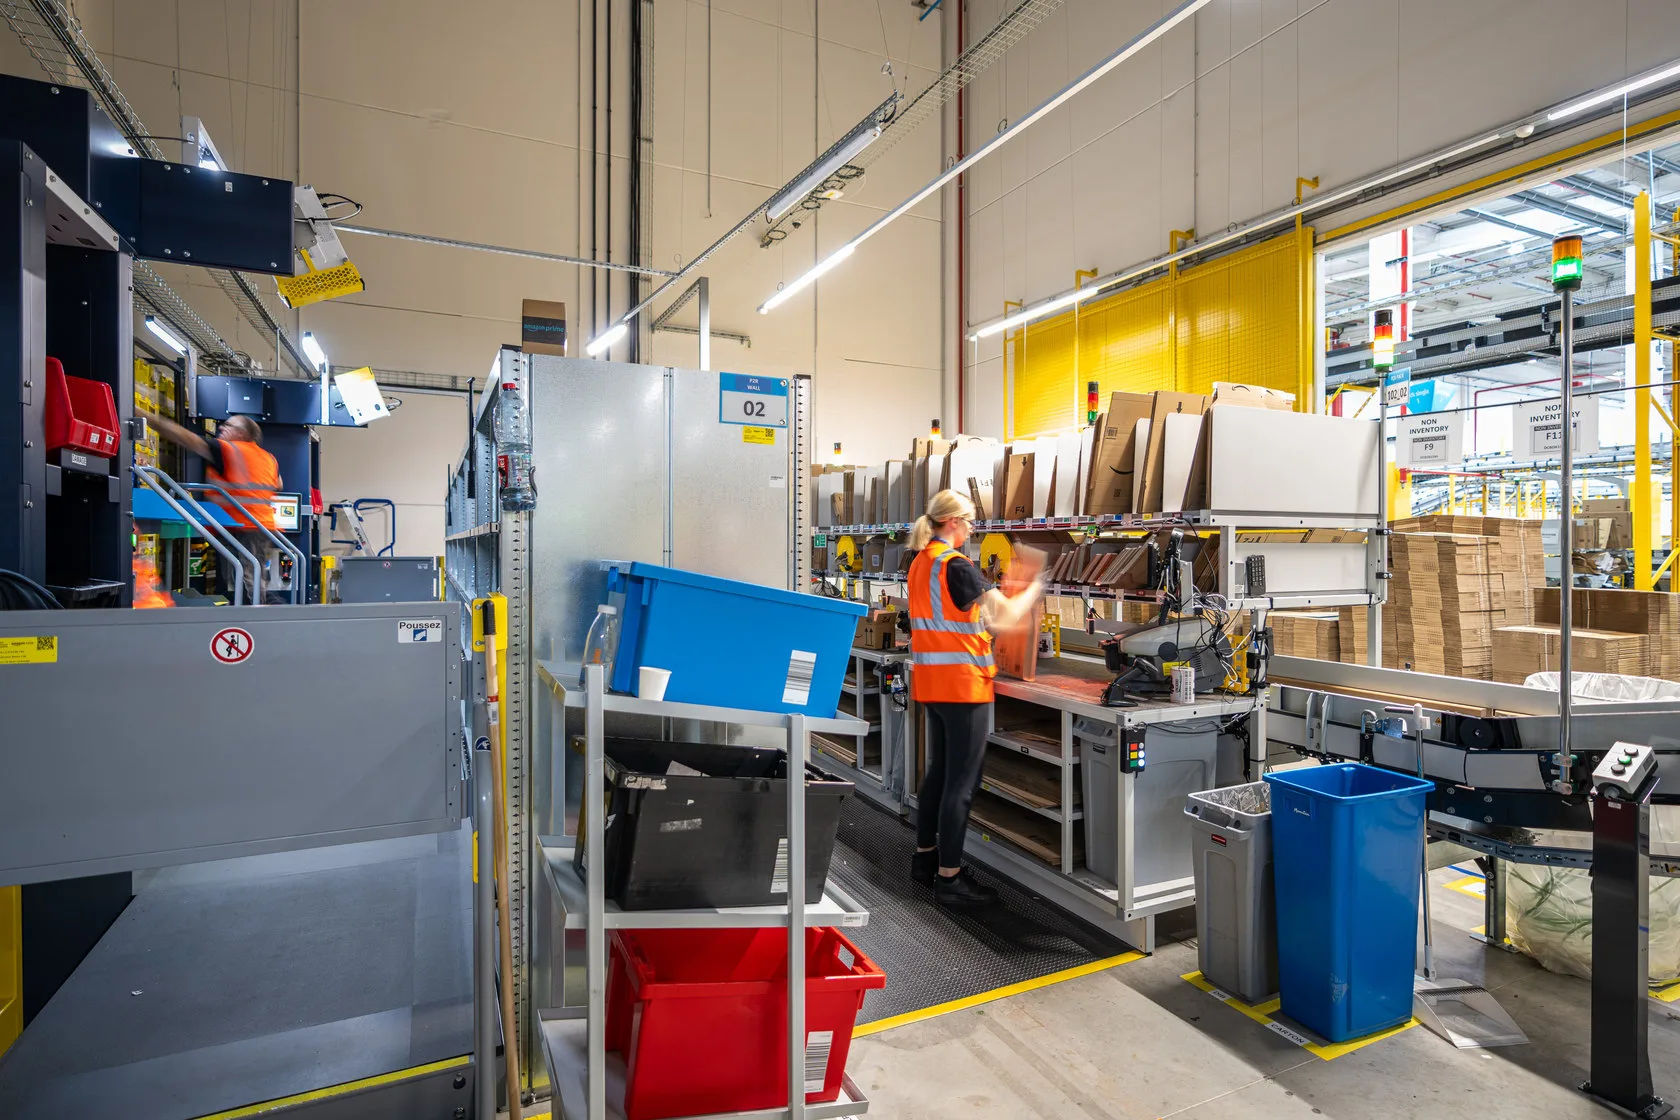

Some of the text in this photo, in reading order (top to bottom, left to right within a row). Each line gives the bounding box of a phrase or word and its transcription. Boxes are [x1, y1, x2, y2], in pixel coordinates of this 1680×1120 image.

[524, 323, 564, 333] amazon prime
[1387, 387, 1407, 401] 102_02
[743, 400, 766, 417] 02
[1530, 411, 1580, 422] INVENTRY
[1421, 418, 1437, 426] NON
[1409, 425, 1449, 435] INVENTORY
[1424, 443, 1434, 451] F9
[1015, 506, 1025, 514] F4
[399, 621, 442, 630] Poussez
[1271, 1022, 1305, 1045] CARTON
